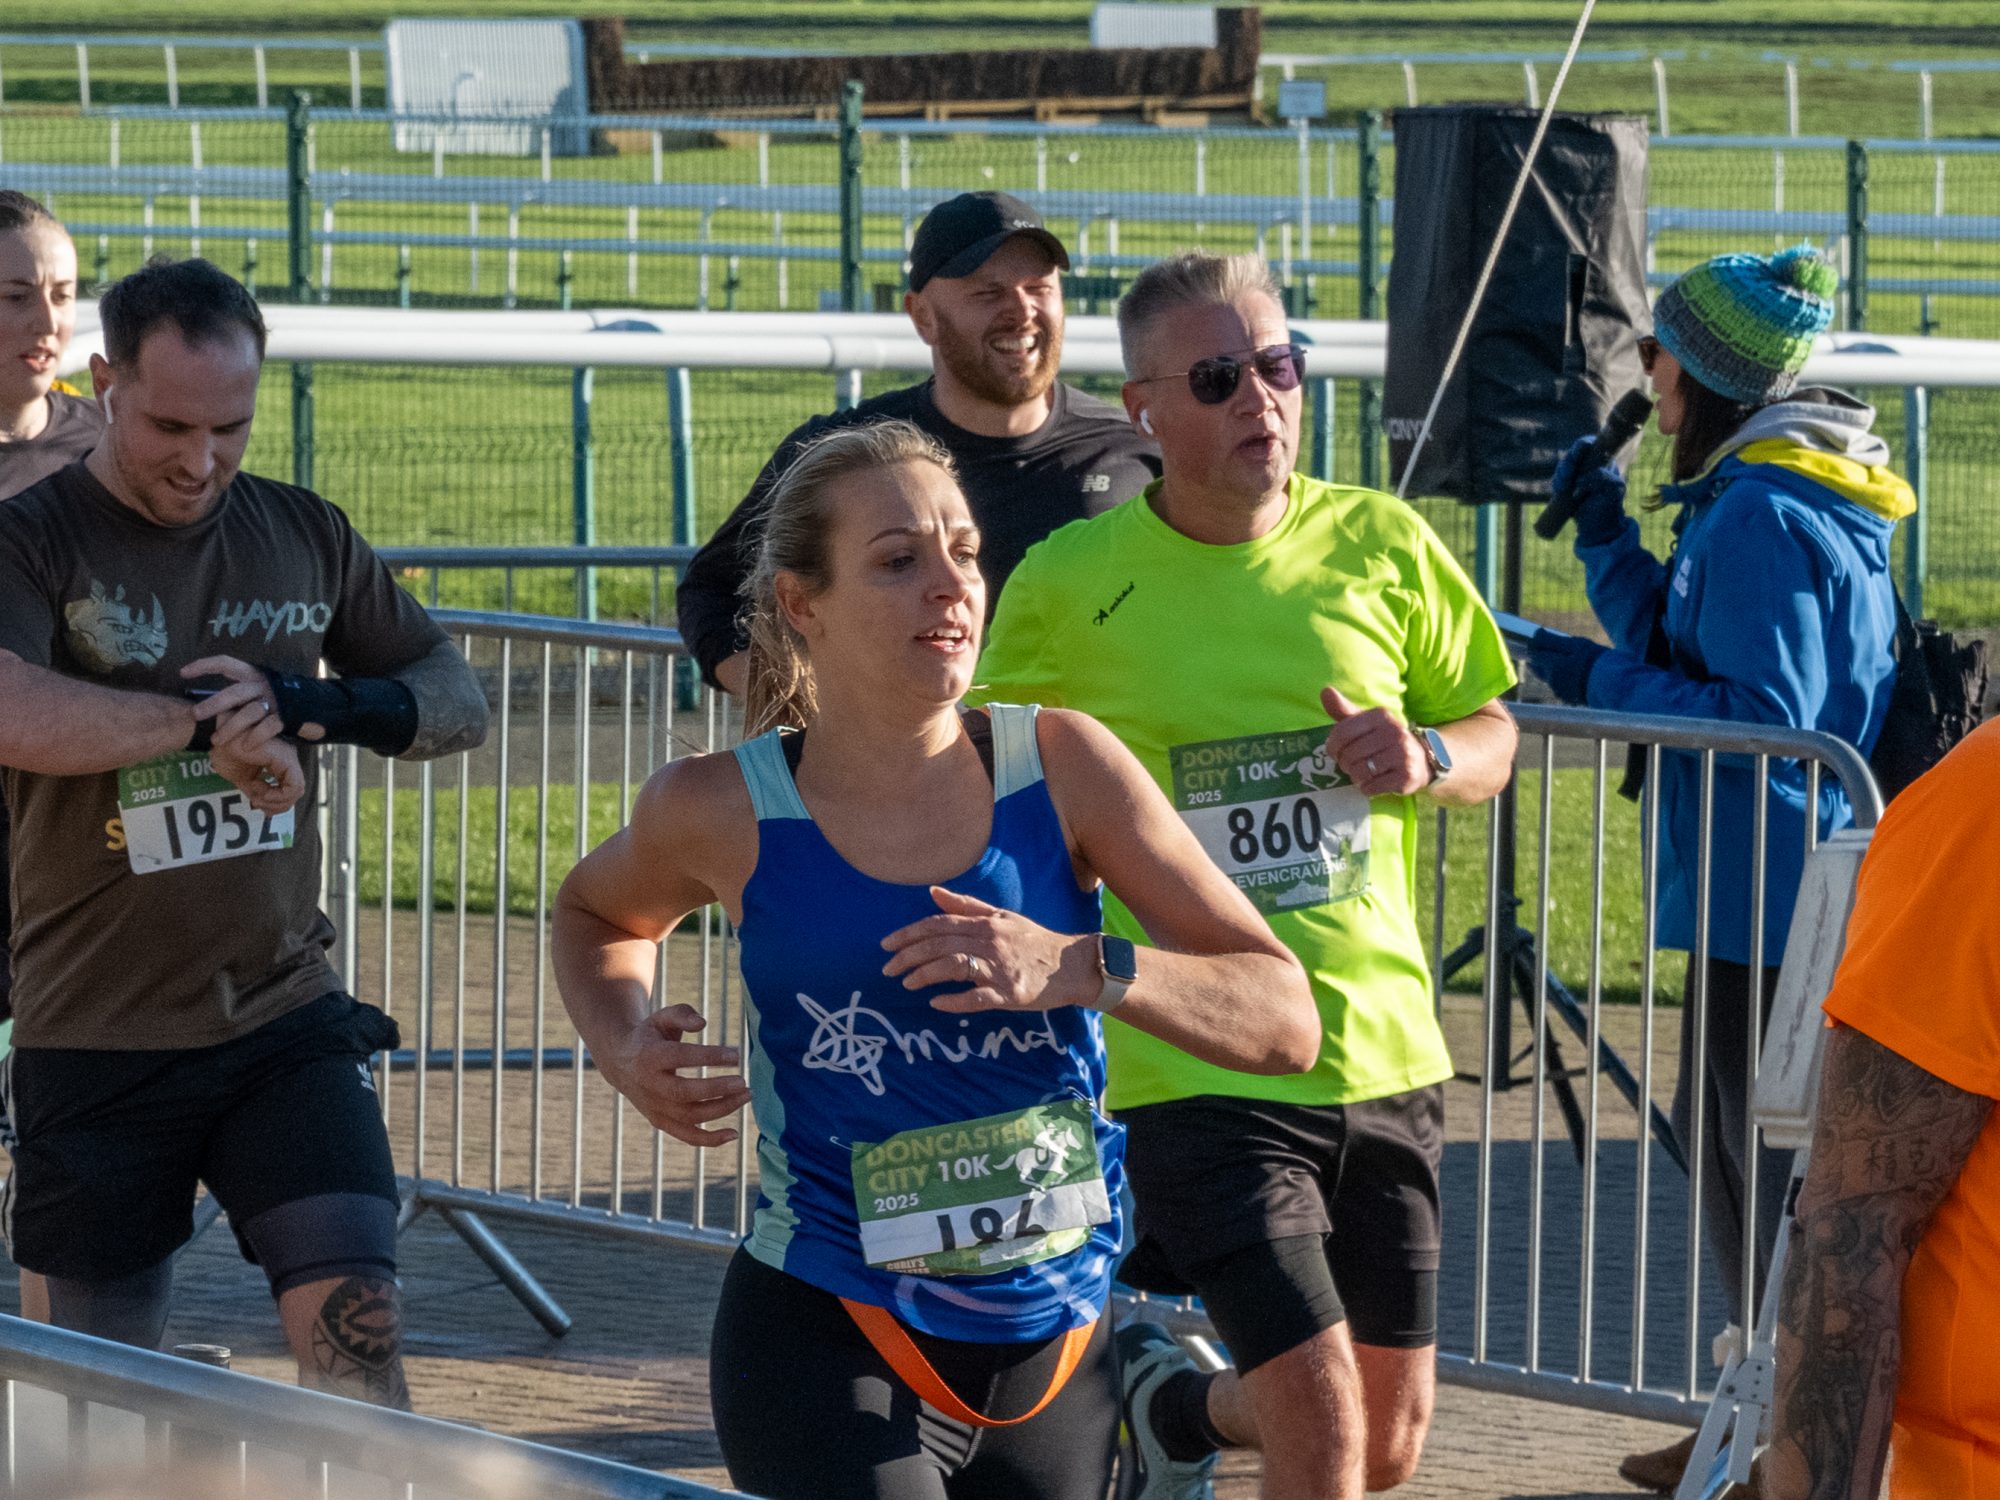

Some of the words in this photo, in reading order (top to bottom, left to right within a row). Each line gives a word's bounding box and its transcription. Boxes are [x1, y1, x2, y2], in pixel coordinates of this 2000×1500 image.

[207, 598, 332, 644] HAYDO
[1181, 735, 1311, 769] DONCASTER
[127, 764, 170, 789] CITY
[1184, 768, 1229, 790] CITY
[1236, 759, 1279, 783] 10K
[131, 786, 166, 803] 2025
[1187, 790, 1222, 805] 2025
[1228, 797, 1321, 864] 860
[866, 1118, 1031, 1168] DONCASTER
[868, 1164, 929, 1194] CITY
[938, 1154, 991, 1183] 10K
[874, 1192, 919, 1214] 2025
